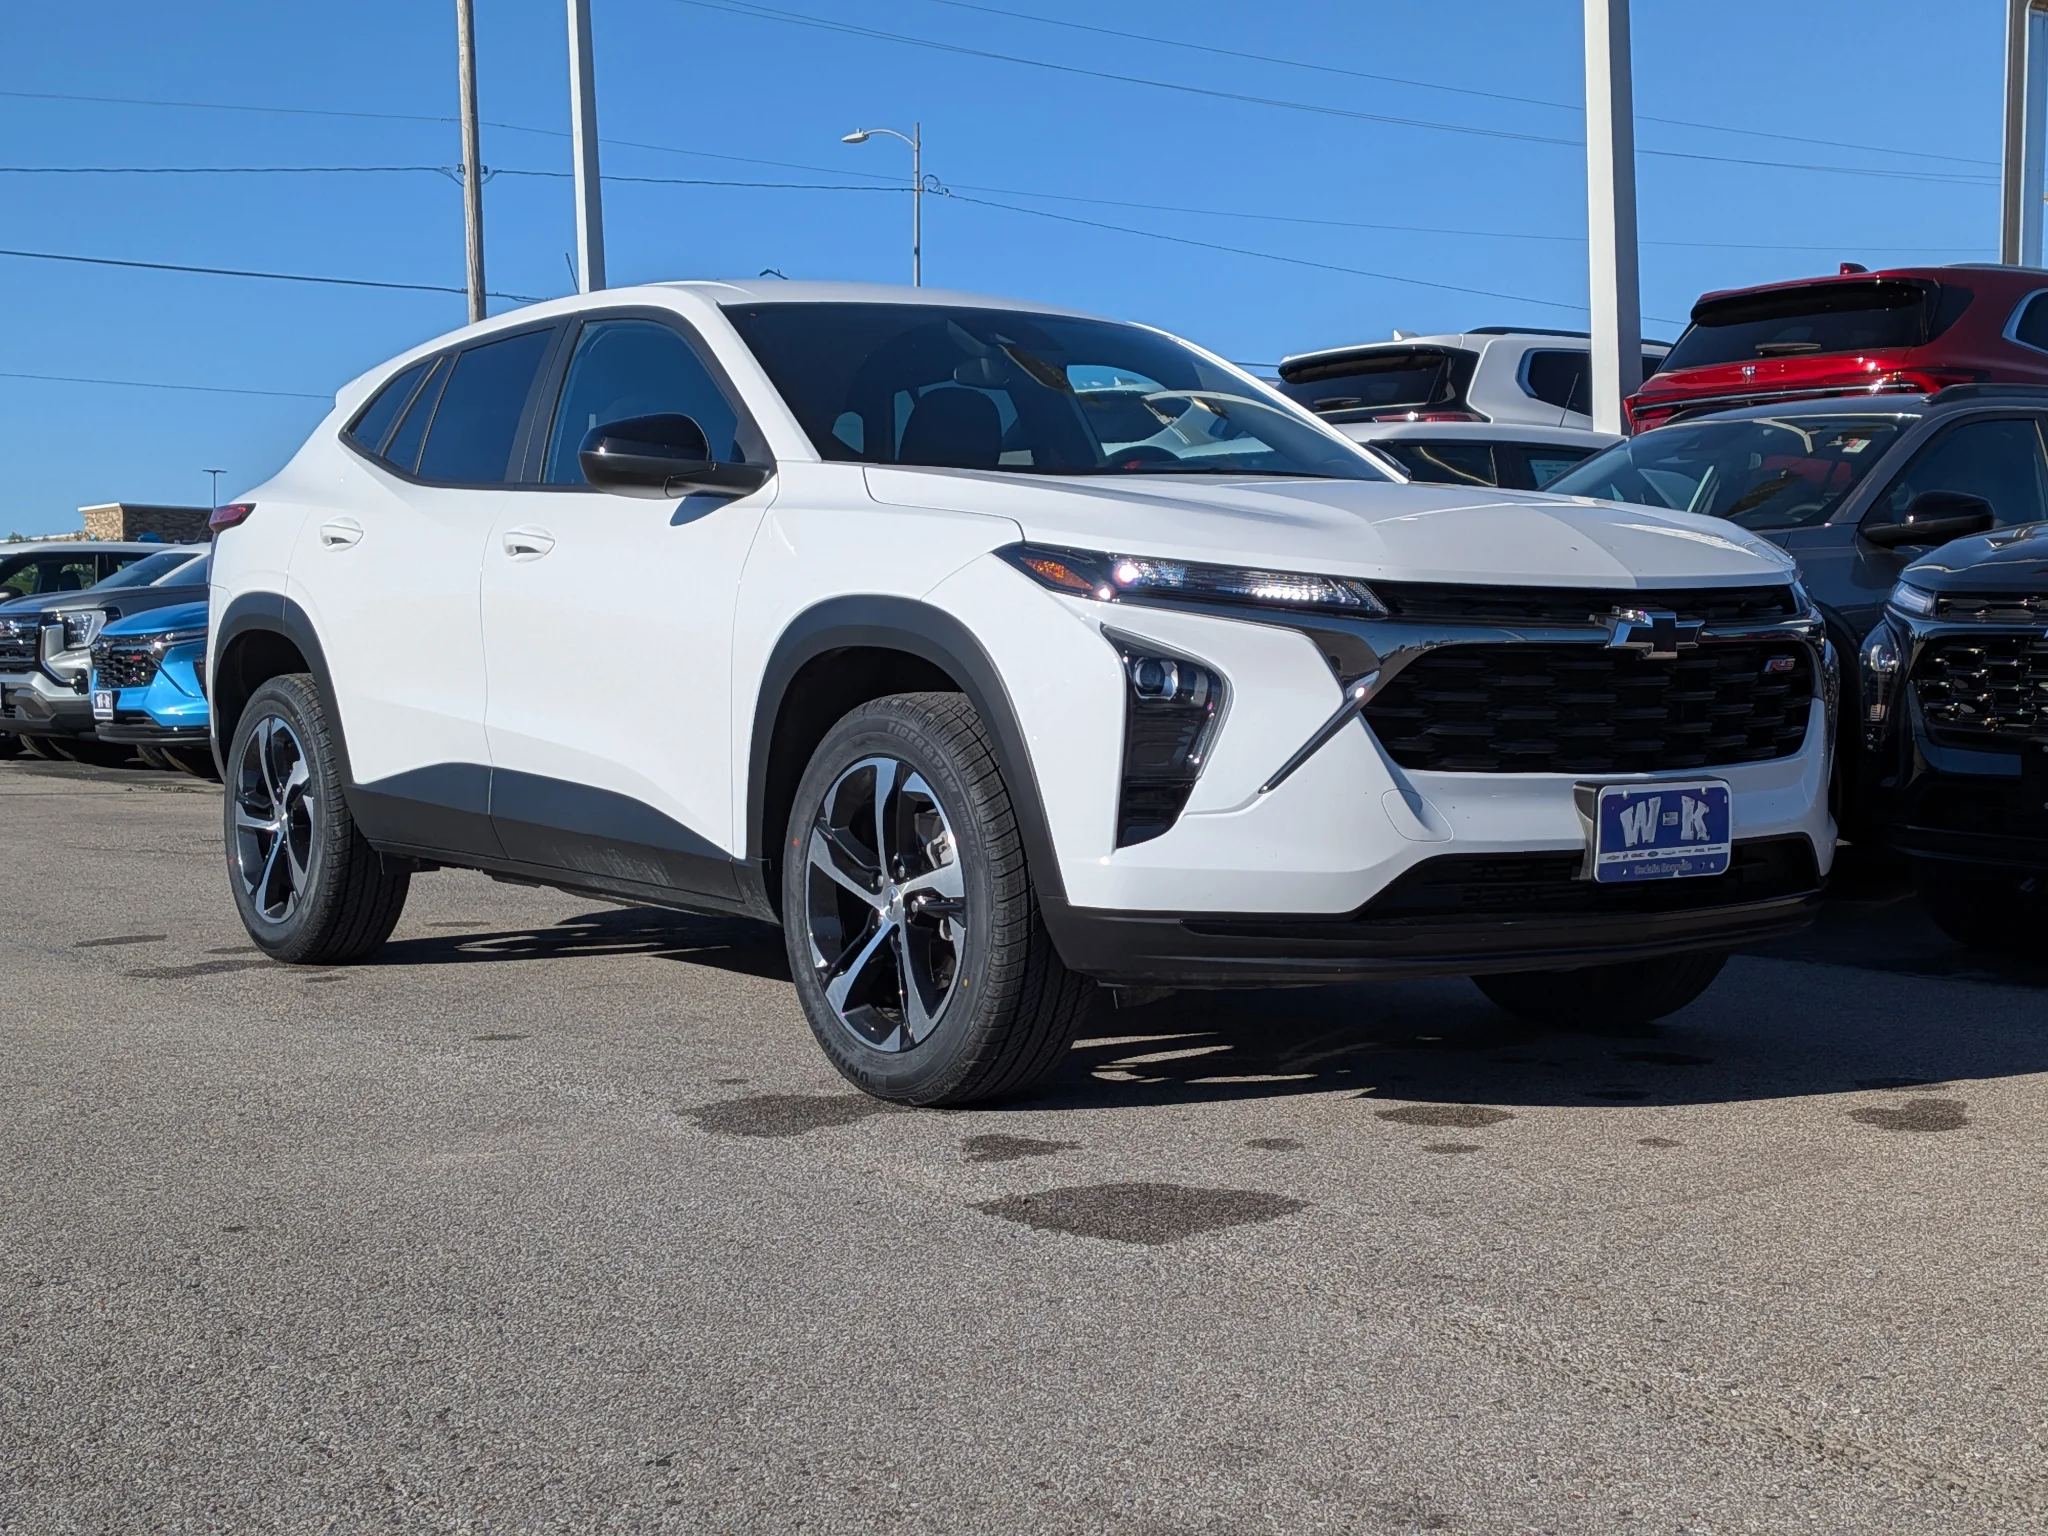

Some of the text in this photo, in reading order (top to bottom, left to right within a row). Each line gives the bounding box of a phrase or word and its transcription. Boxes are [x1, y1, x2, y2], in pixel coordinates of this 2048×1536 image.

[1764, 657, 1796, 673] RS
[886, 720, 927, 750] TIGER
[931, 754, 960, 793] PAW
